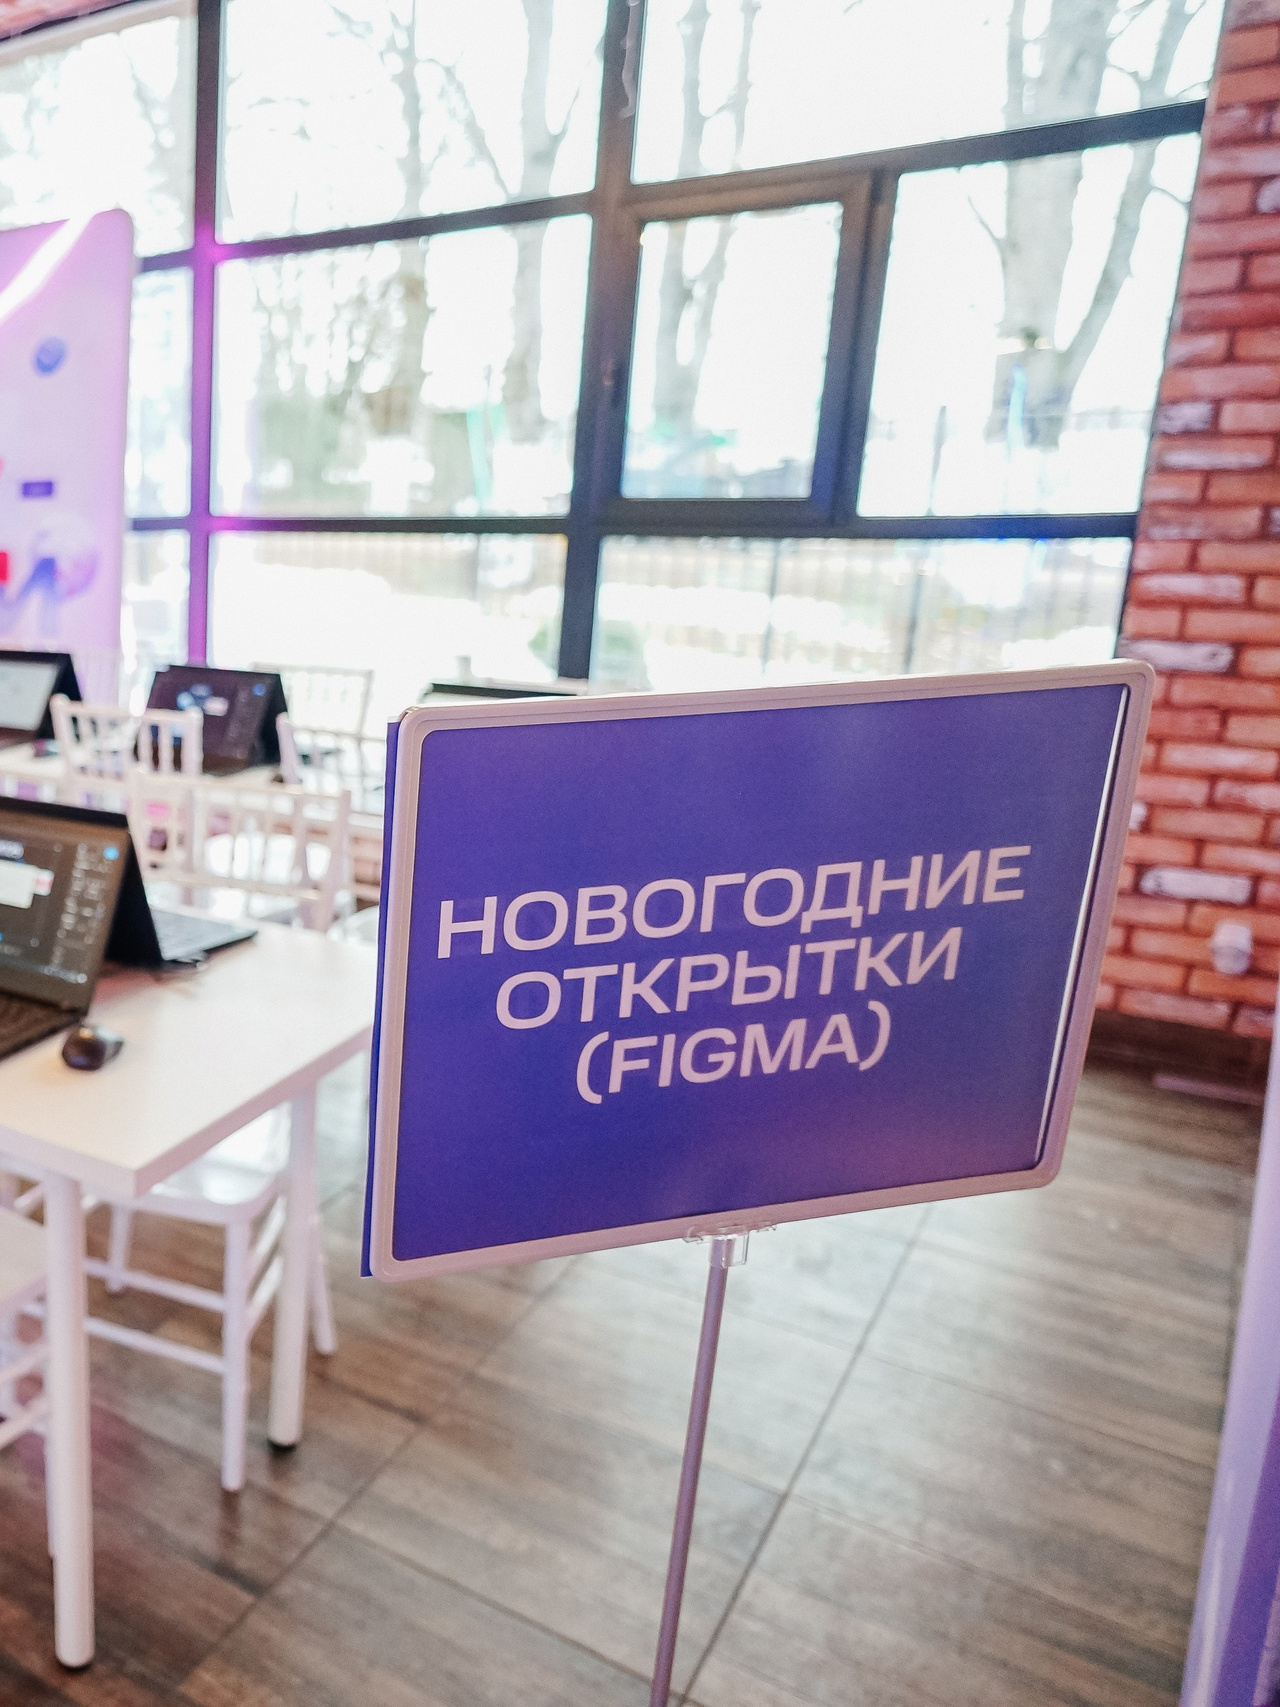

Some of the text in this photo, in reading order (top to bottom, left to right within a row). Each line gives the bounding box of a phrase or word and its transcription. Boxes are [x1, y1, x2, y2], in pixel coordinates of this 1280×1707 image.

[437, 845, 1032, 959] НОВОГОДНИЕ
[496, 927, 963, 1030] ОТКРЫТКИ
[576, 1000, 891, 1104] (FIGMA)
